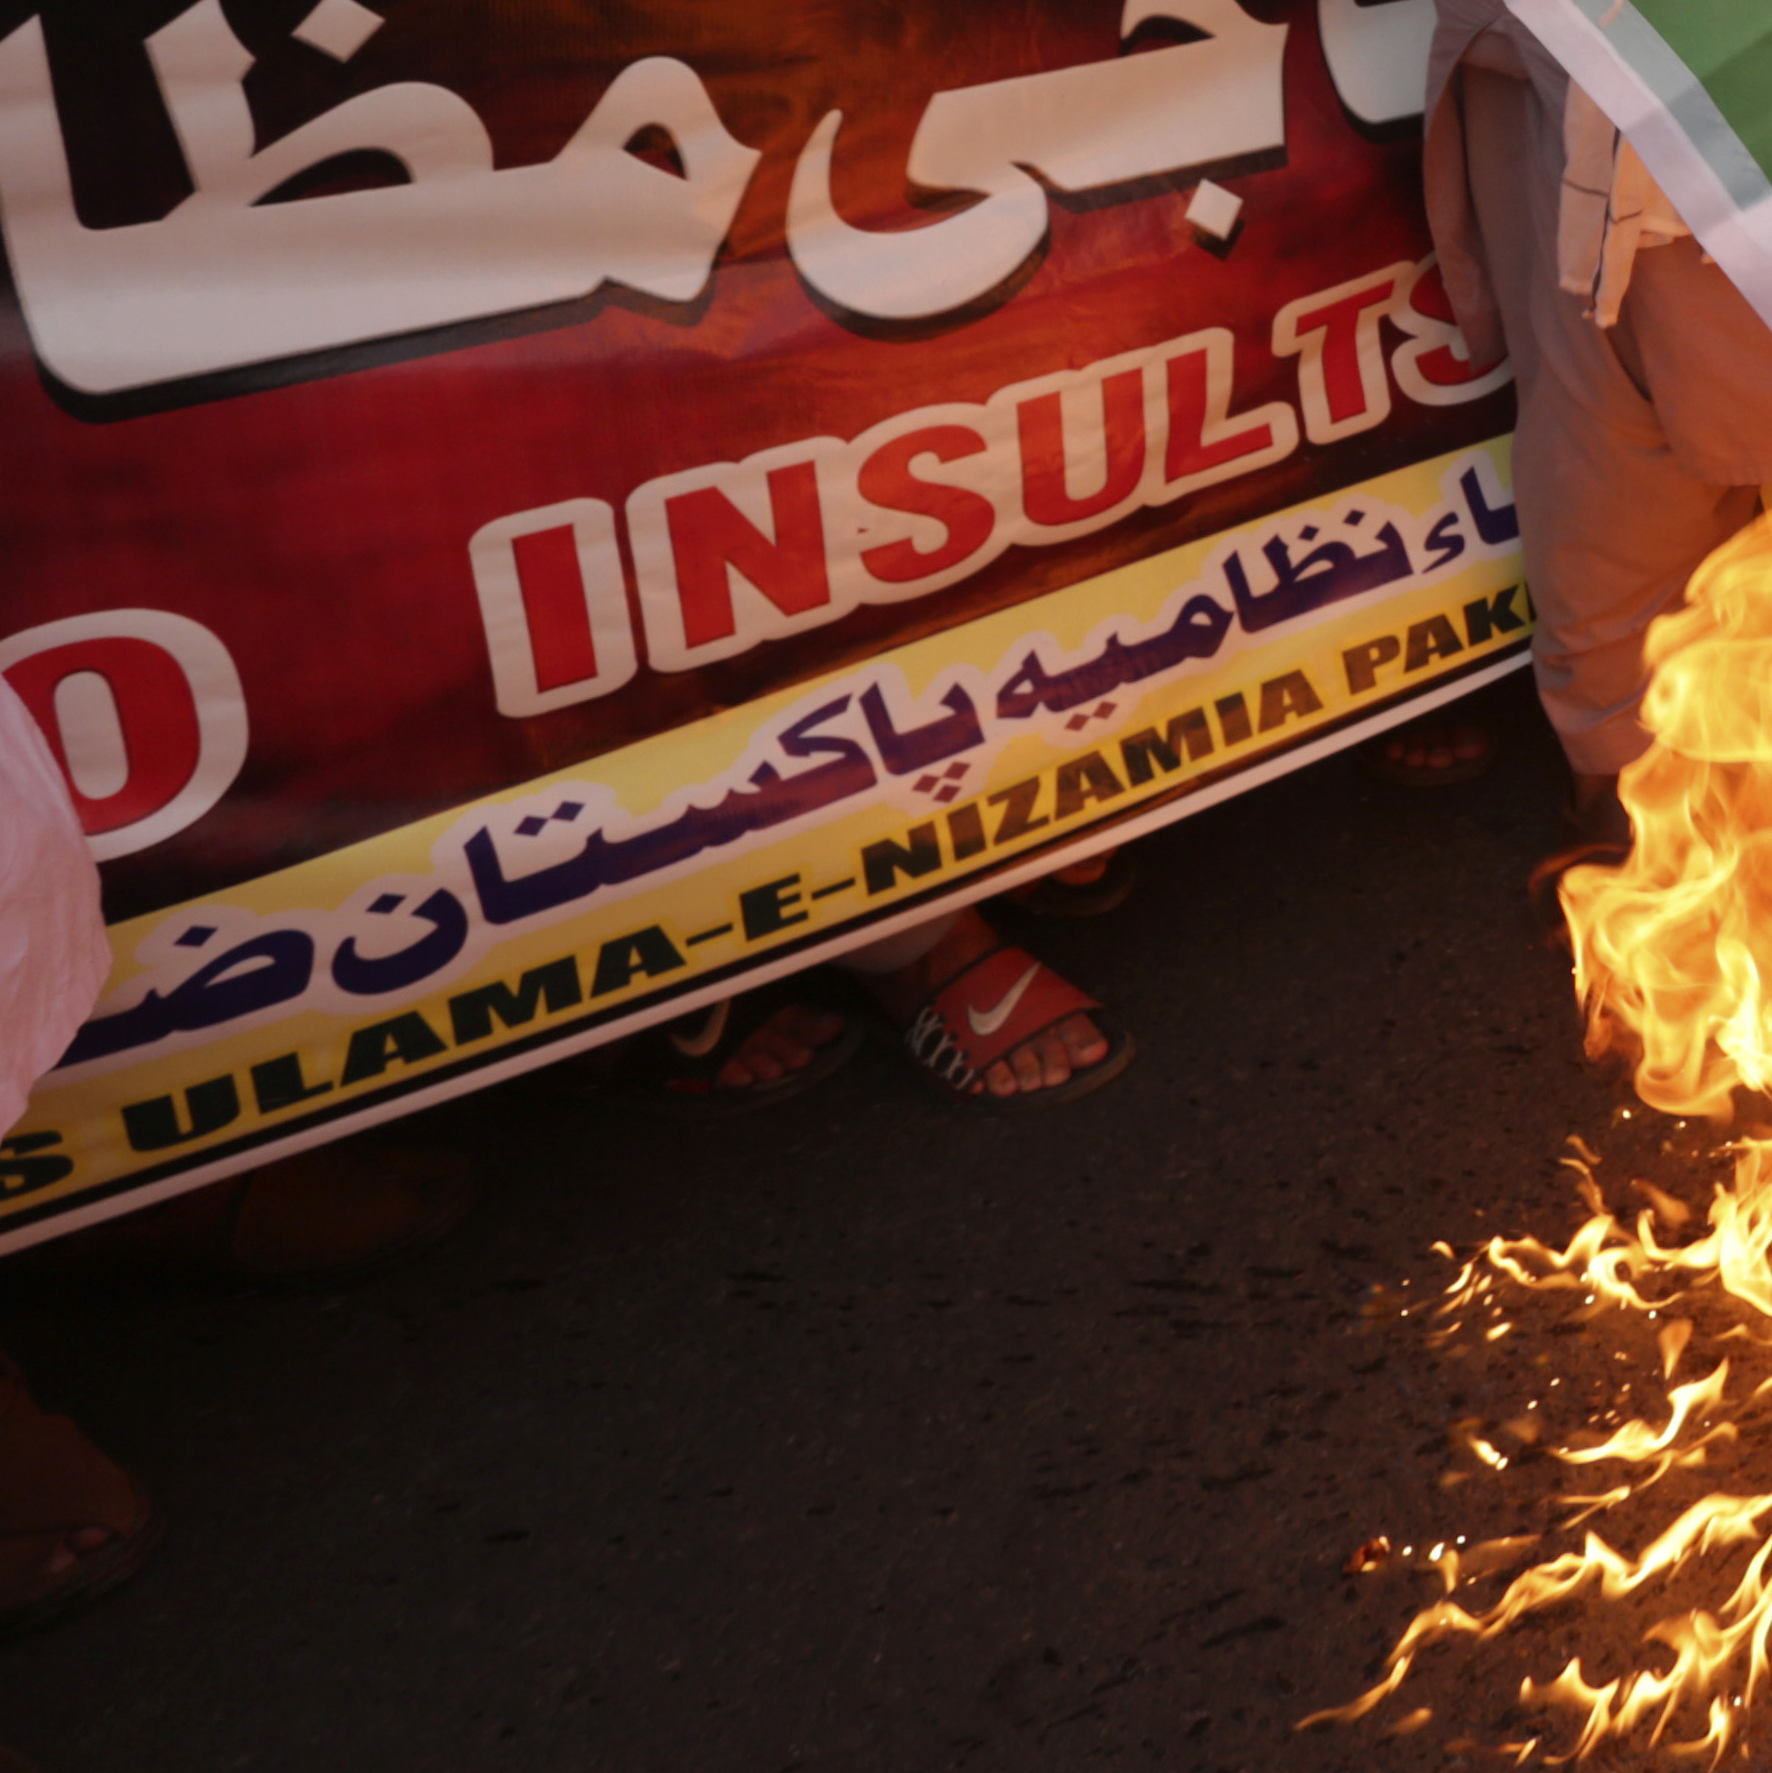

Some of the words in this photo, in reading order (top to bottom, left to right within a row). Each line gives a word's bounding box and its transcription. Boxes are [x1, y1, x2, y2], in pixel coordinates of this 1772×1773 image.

[480, 256, 1516, 710] INSULTS
[996, 508, 1414, 732] نظامیہ
[121, 669, 1324, 1152] ULAMA-E-NIZAMIA
[1341, 578, 1535, 696] PAK
[331, 681, 985, 997] پاکستان
